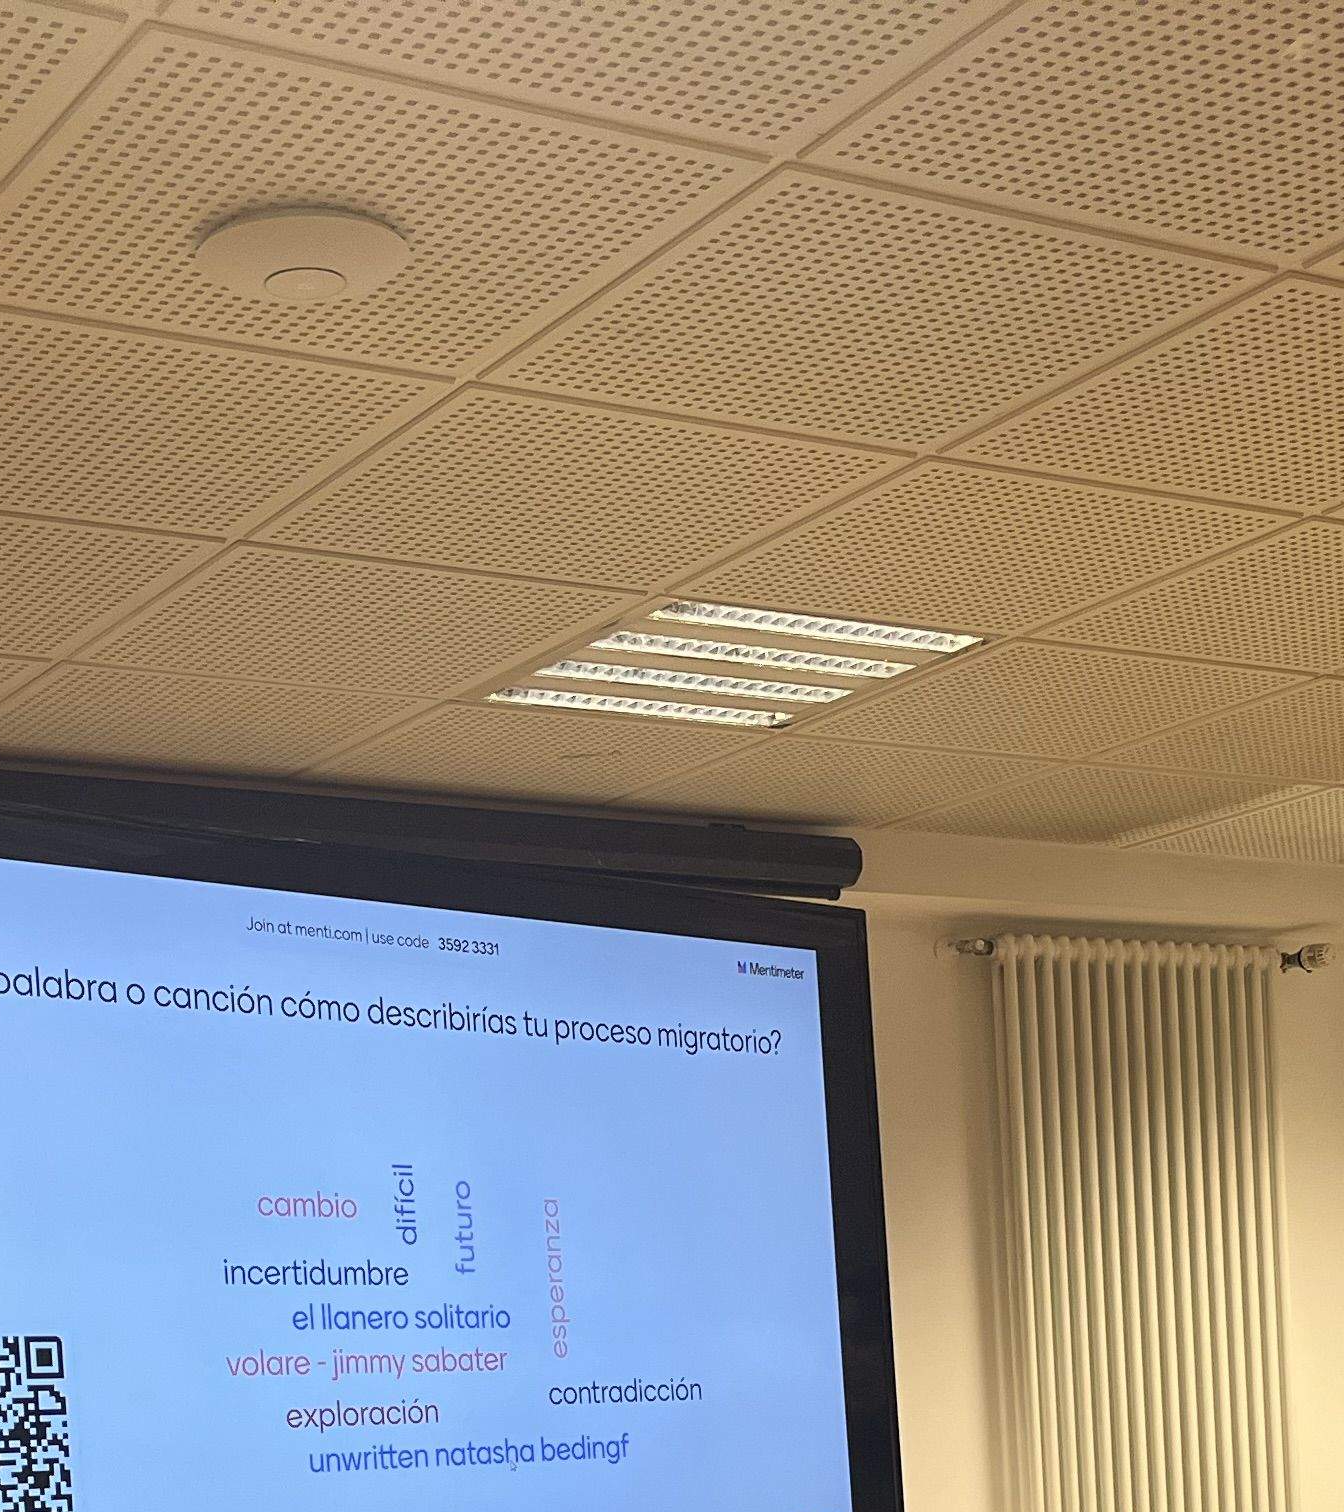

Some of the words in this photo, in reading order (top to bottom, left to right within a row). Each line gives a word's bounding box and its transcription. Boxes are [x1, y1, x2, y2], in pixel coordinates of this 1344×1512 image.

[247, 917, 274, 932] Join
[278, 921, 292, 934] at
[296, 926, 362, 942] menti.com
[372, 934, 394, 945] use
[397, 935, 429, 948] code
[439, 937, 469, 953] 3592
[472, 941, 498, 955] 3331
[750, 962, 804, 979] Mentimeter
[127, 984, 145, 1005] o
[154, 985, 272, 1015] canción
[281, 991, 359, 1022] cómo
[368, 997, 517, 1035] describirías
[523, 1011, 547, 1037] tu
[555, 1020, 651, 1045] proceso
[658, 1023, 781, 1055] migratorio?
[258, 1191, 357, 1218] cambio
[392, 1165, 417, 1245] difícil
[455, 1181, 475, 1274] futuro
[224, 1259, 408, 1285] incertidumbre
[544, 1200, 570, 1358] esperanza
[293, 1303, 314, 1330] el
[322, 1303, 408, 1329] llanero
[415, 1303, 510, 1329] solitario
[226, 1349, 310, 1376] volare
[332, 1349, 405, 1380] jimmy
[412, 1347, 507, 1372] sabater
[549, 1377, 702, 1405] contradicción
[287, 1399, 438, 1433] exploración
[310, 1444, 428, 1472] unwritten
[436, 1438, 534, 1468] natasha
[541, 1433, 629, 1464] bedingf
